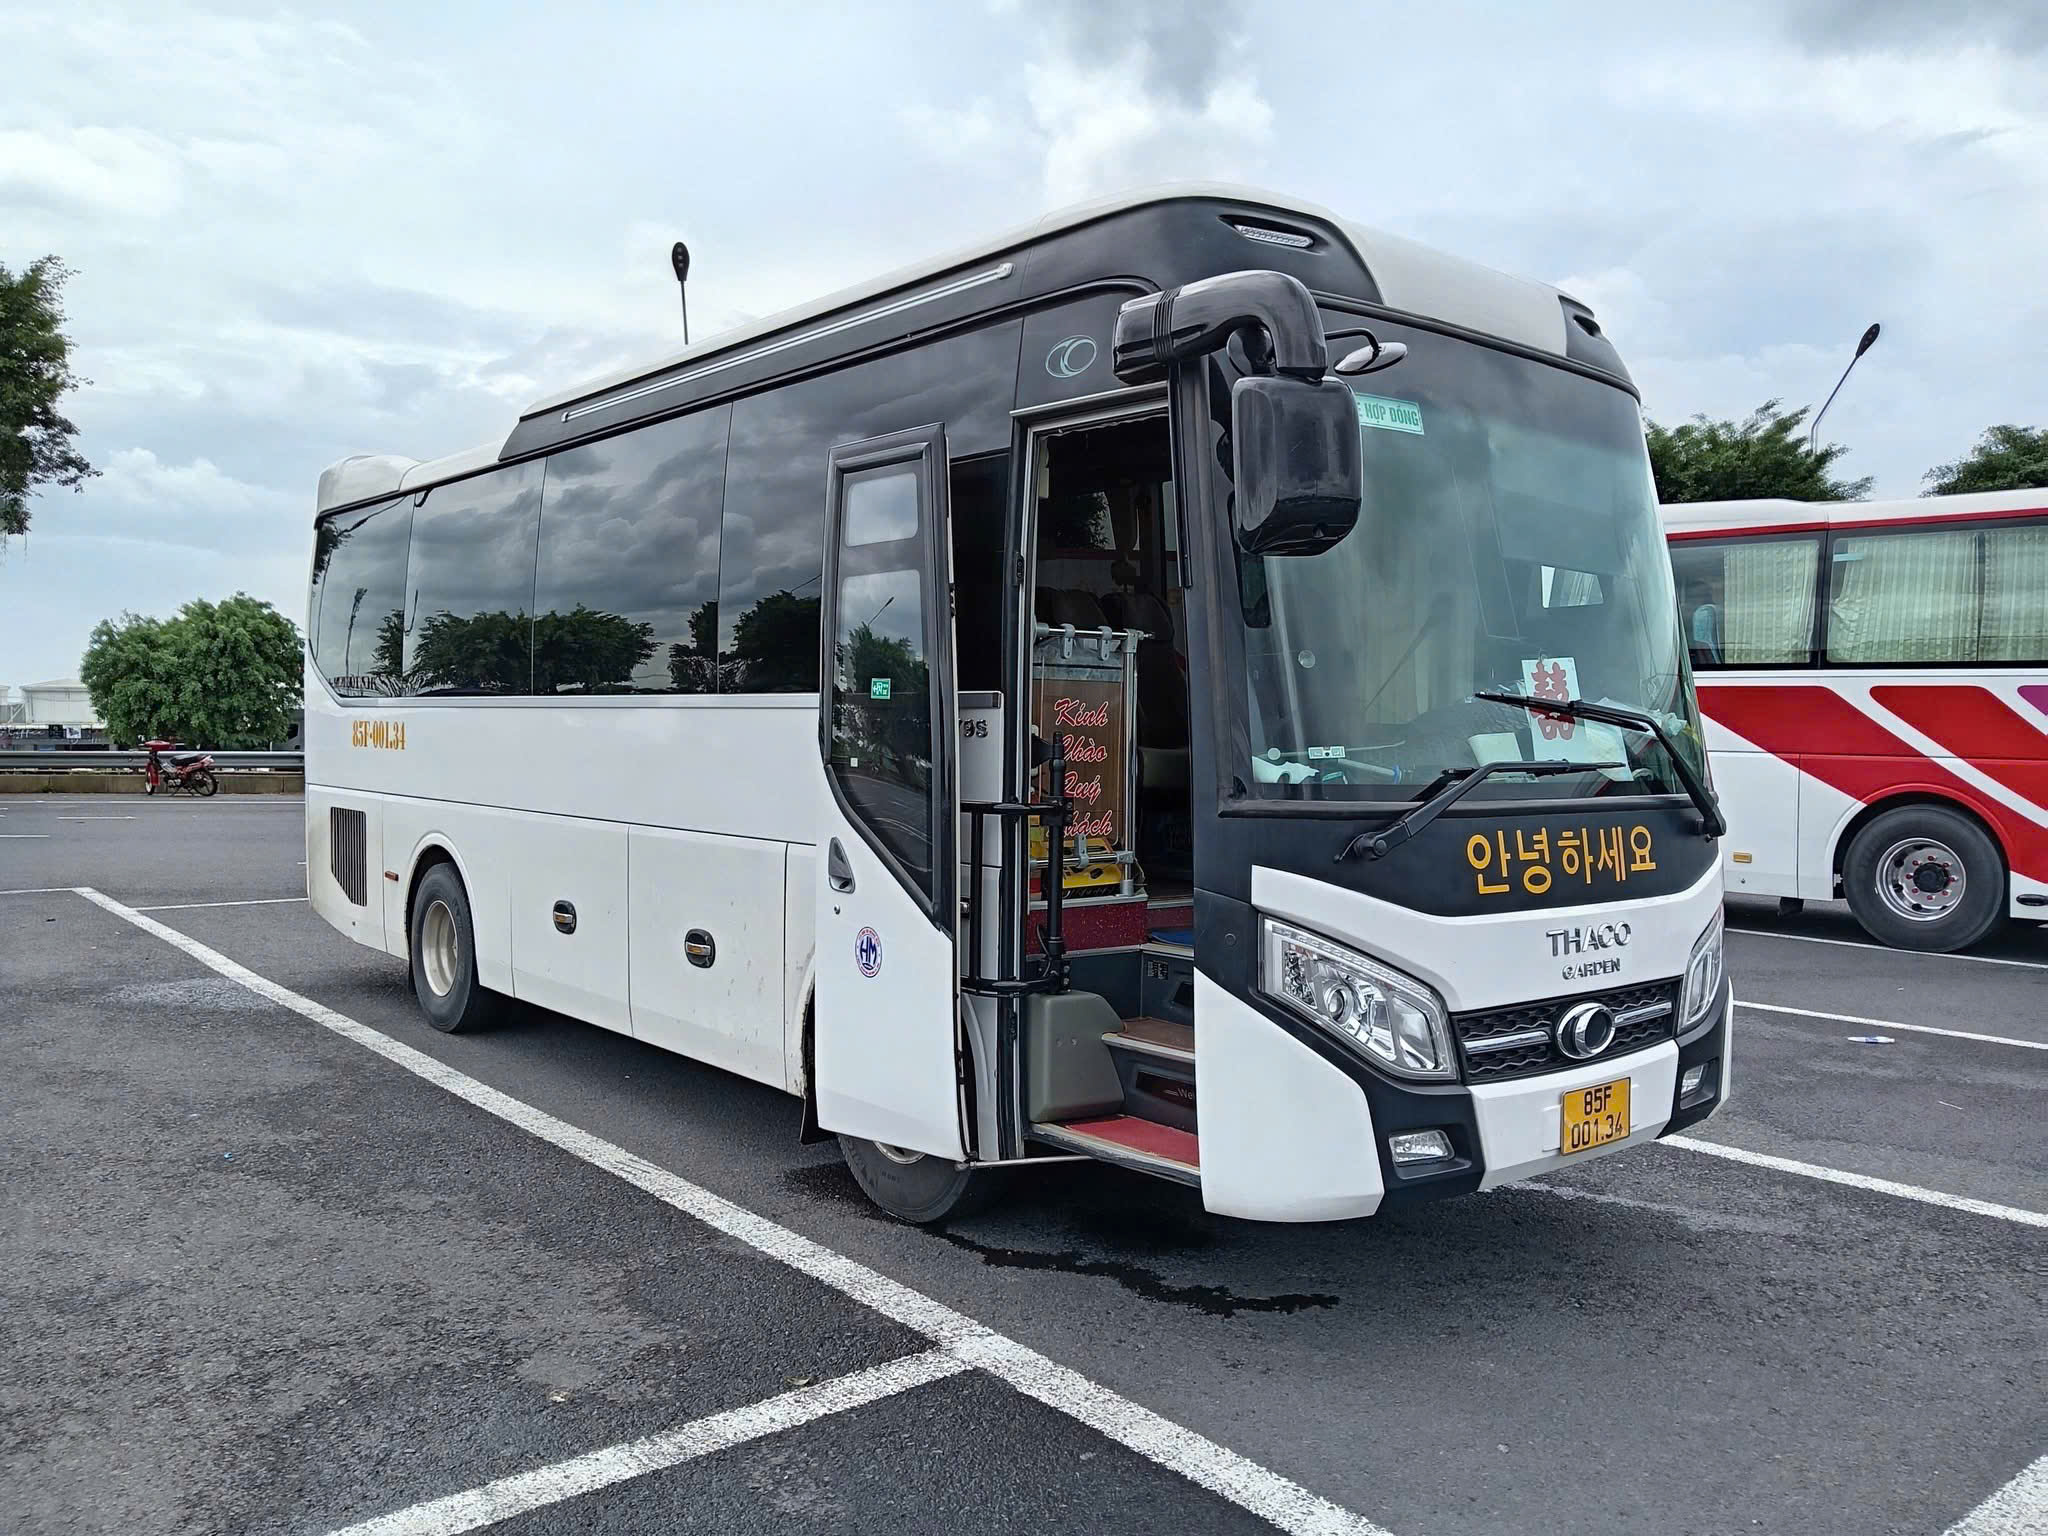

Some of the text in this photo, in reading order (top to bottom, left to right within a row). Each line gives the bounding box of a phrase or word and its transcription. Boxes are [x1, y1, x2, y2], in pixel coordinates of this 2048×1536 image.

[1364, 403, 1386, 423] HỢP
[1054, 698, 1109, 727] Kính
[352, 720, 406, 750] 85F-001.34
[1466, 825, 1657, 895] 안녕하세요
[1546, 921, 1631, 957] THACO
[1562, 957, 1620, 980] GARDEN
[1584, 1085, 1613, 1116] 85F
[1571, 1112, 1623, 1149] 001.34
